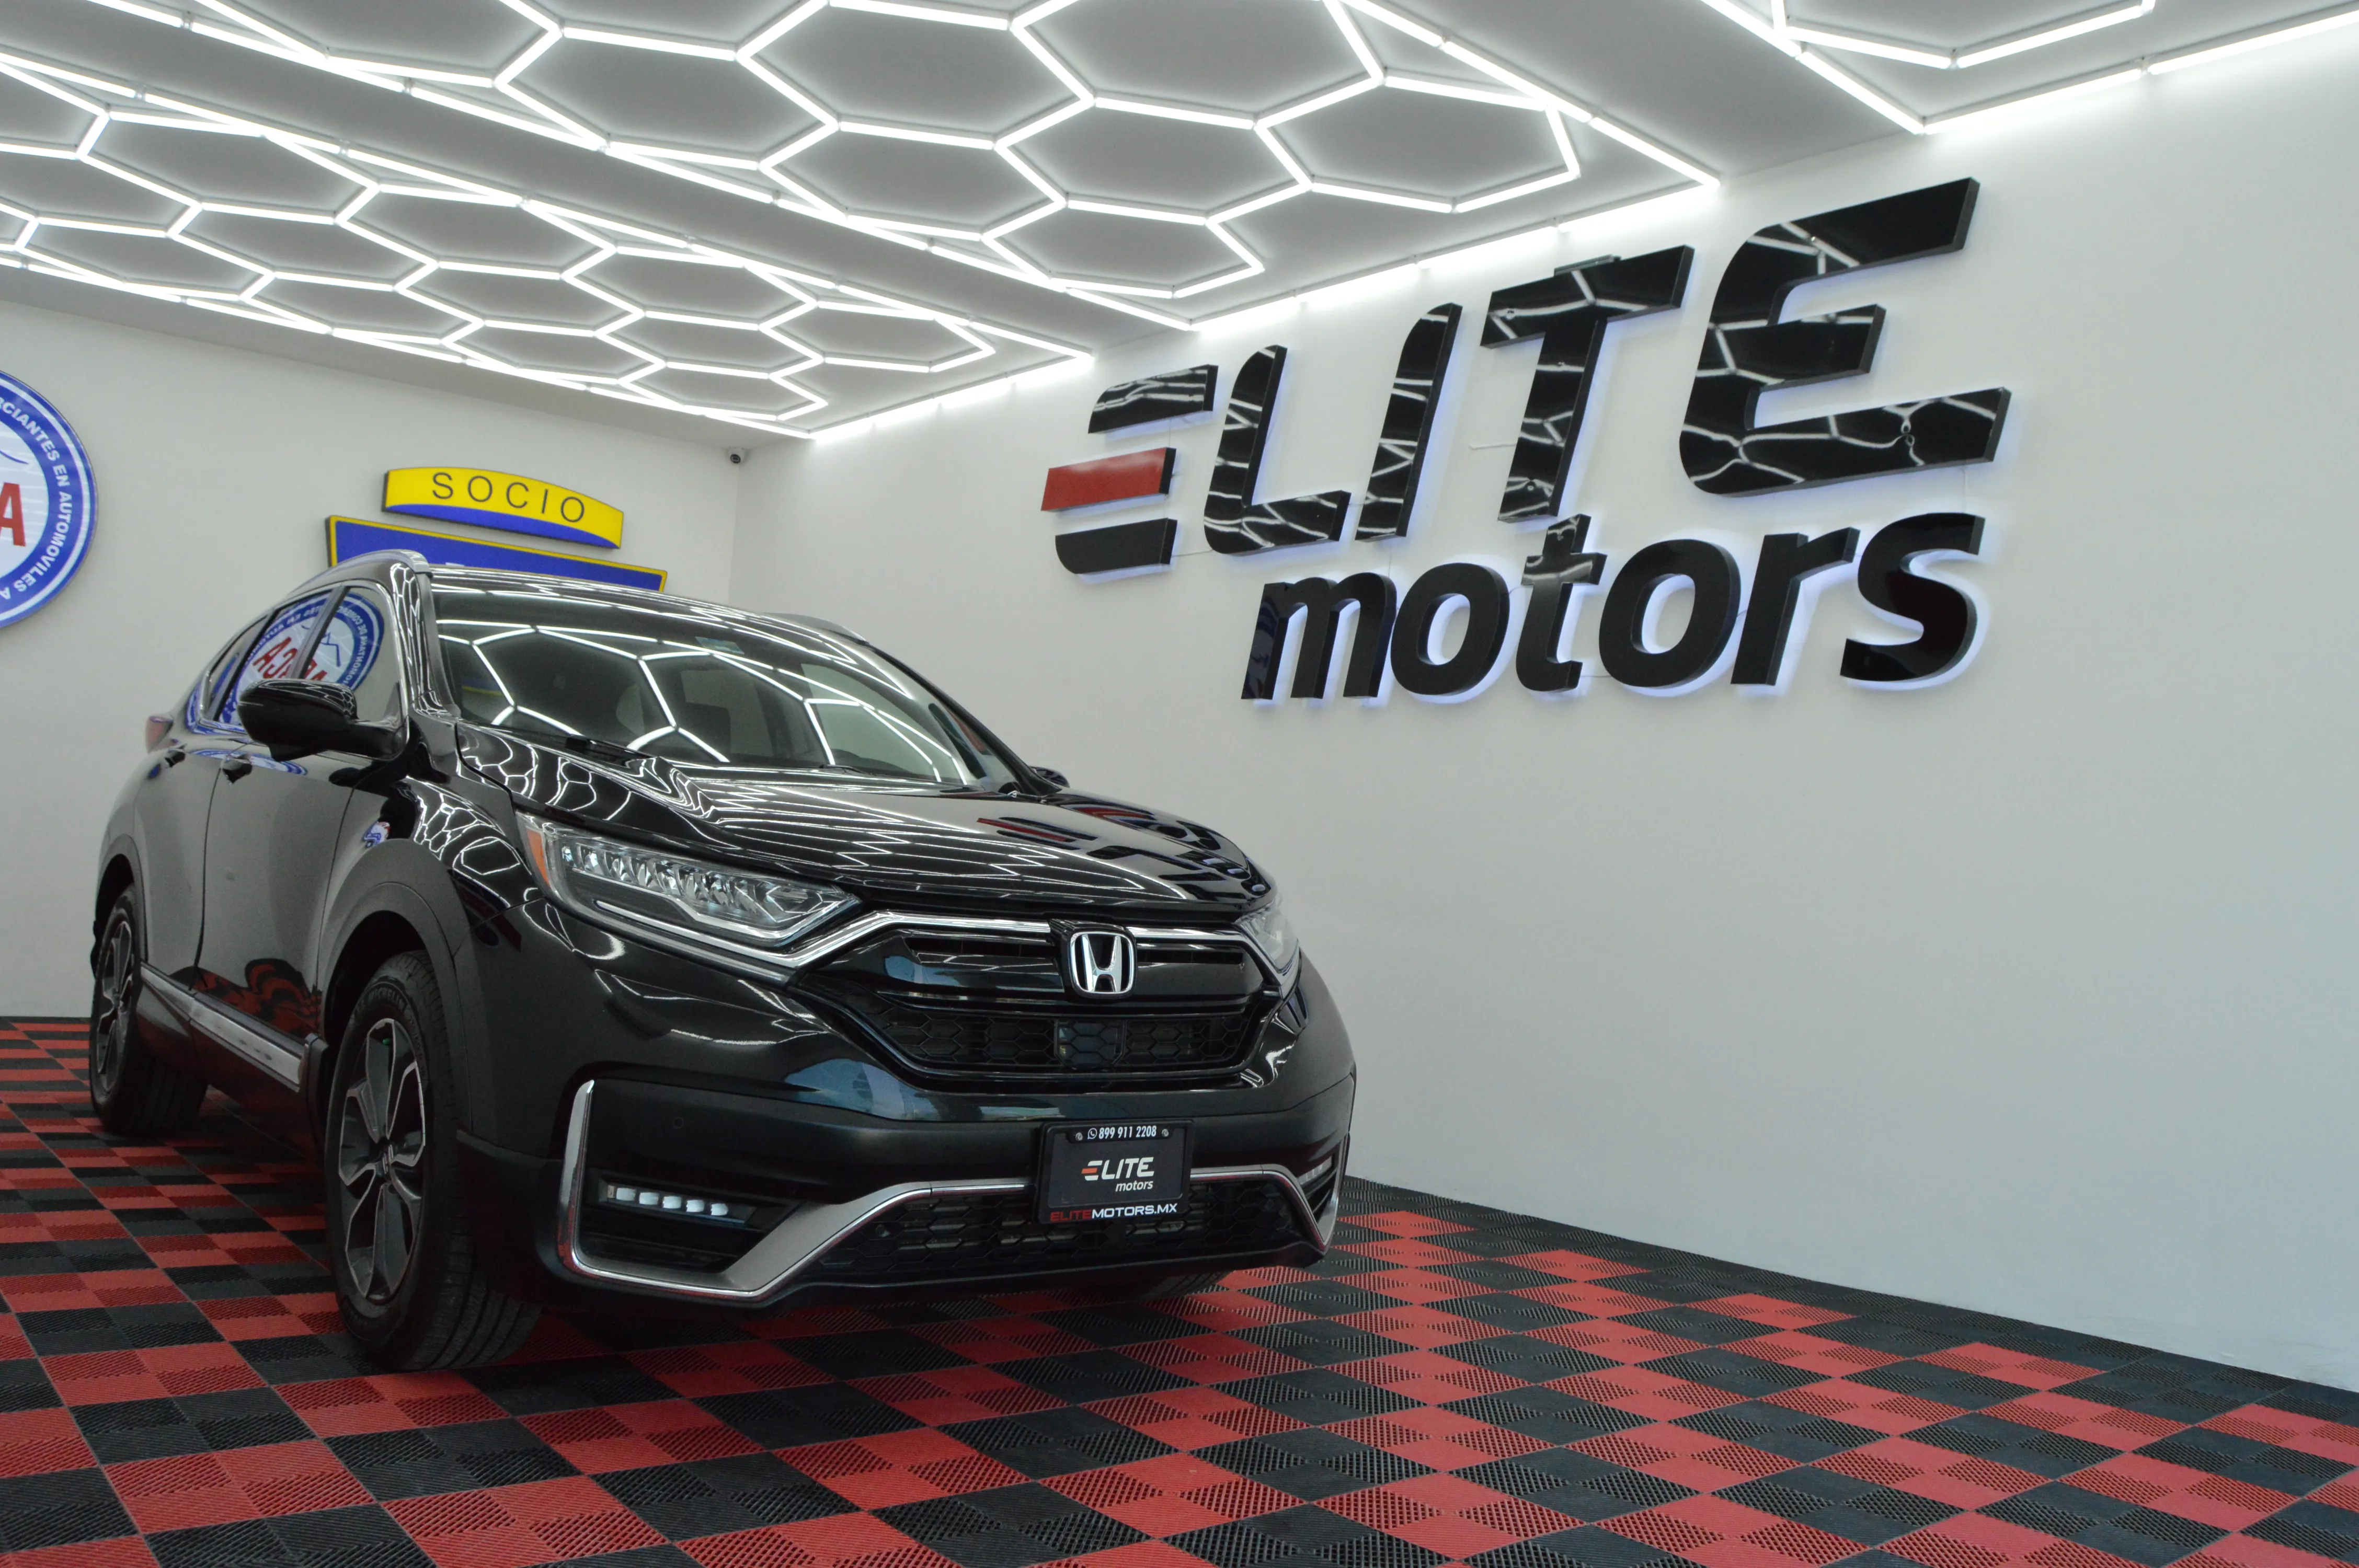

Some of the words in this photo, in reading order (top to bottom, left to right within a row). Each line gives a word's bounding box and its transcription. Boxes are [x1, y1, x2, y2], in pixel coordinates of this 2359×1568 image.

[1041, 178, 2011, 574] ELITE
[53, 464, 70, 487] EN
[432, 472, 585, 523] SOCIO
[14, 491, 72, 592] AUTOMOVILES
[1241, 512, 1986, 699] motors
[1098, 1127, 1116, 1139] 899
[1117, 1126, 1132, 1138] 911
[1136, 1125, 1156, 1138] 2208
[1081, 1157, 1154, 1181] ELITE
[1115, 1180, 1153, 1192] motors
[1050, 1203, 1178, 1221] ELITEMOTORS.MX
